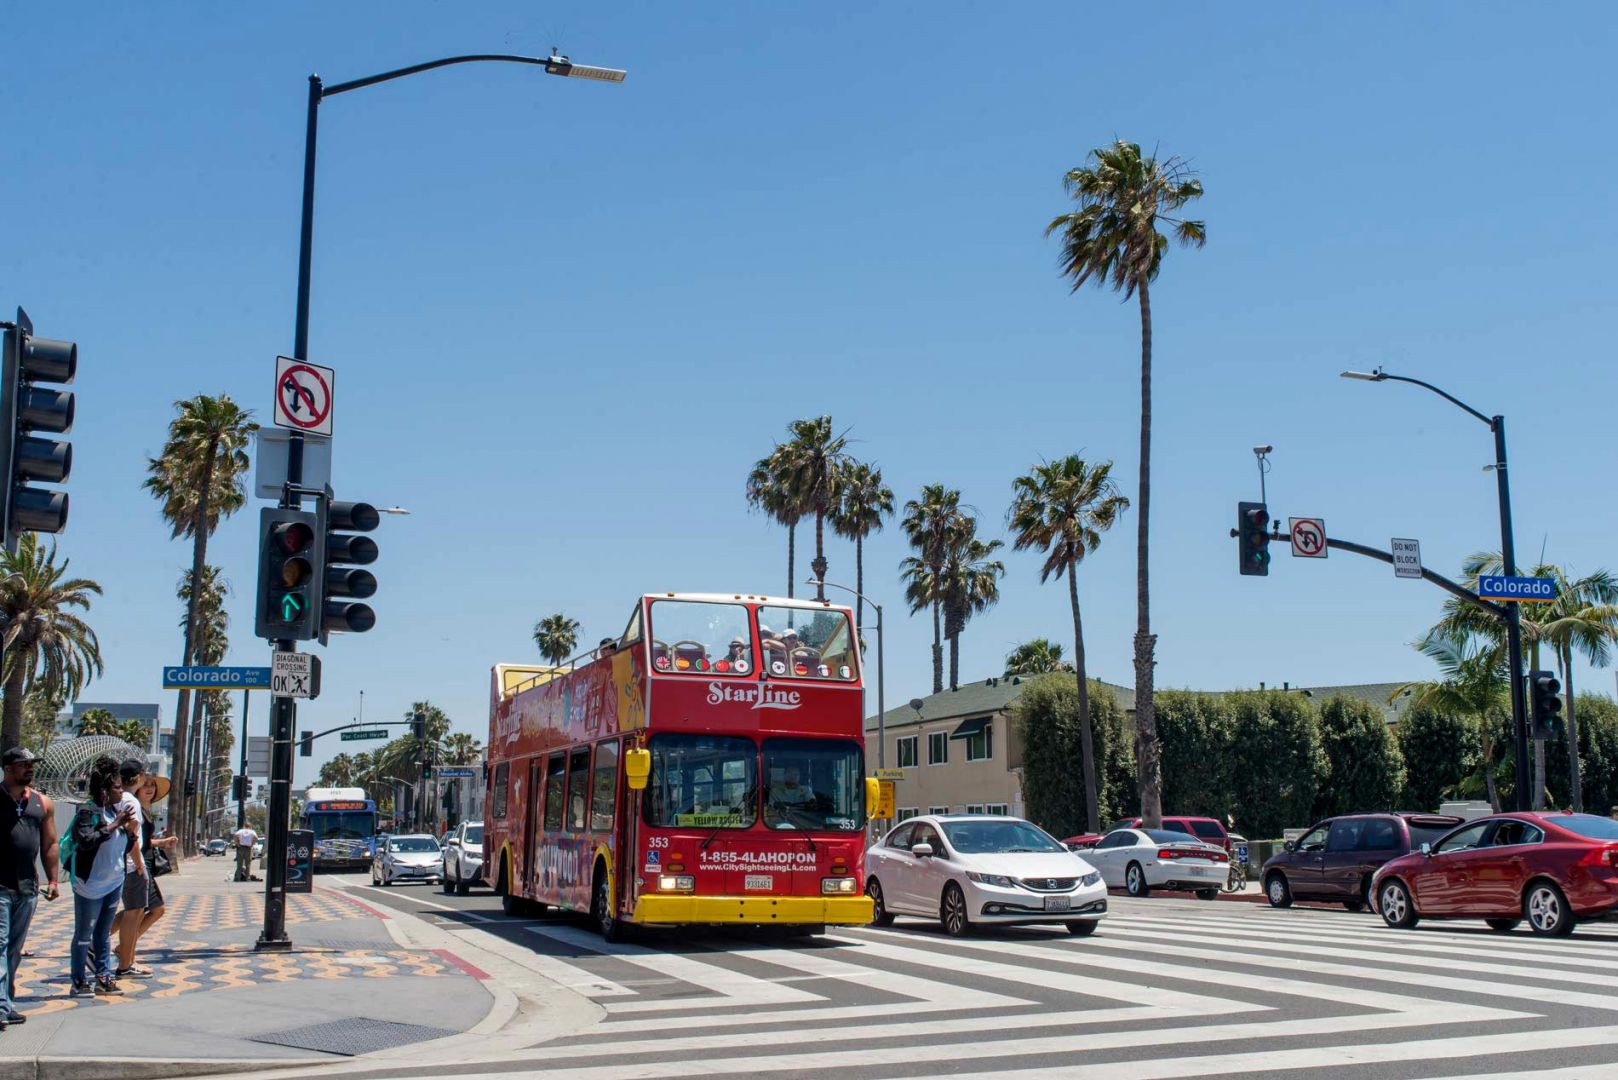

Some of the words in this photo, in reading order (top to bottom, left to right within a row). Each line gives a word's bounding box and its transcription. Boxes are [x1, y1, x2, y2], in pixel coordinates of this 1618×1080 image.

[1394, 543, 1403, 551] DO
[1404, 543, 1417, 552] NOT
[1396, 555, 1418, 564] BLOCK
[1483, 578, 1551, 595] Colorado
[276, 654, 307, 664] DIAGONAL
[276, 663, 307, 672] CROSSING
[166, 669, 241, 683] Colorado
[273, 675, 288, 692] OK
[706, 681, 803, 710] StarLine
[693, 816, 717, 825] YELLOW
[839, 819, 856, 830] 353
[648, 837, 669, 848] 353
[700, 851, 816, 863] 1-855-4LAHOPON
[699, 863, 817, 872] www.CitySightseeingLA.com
